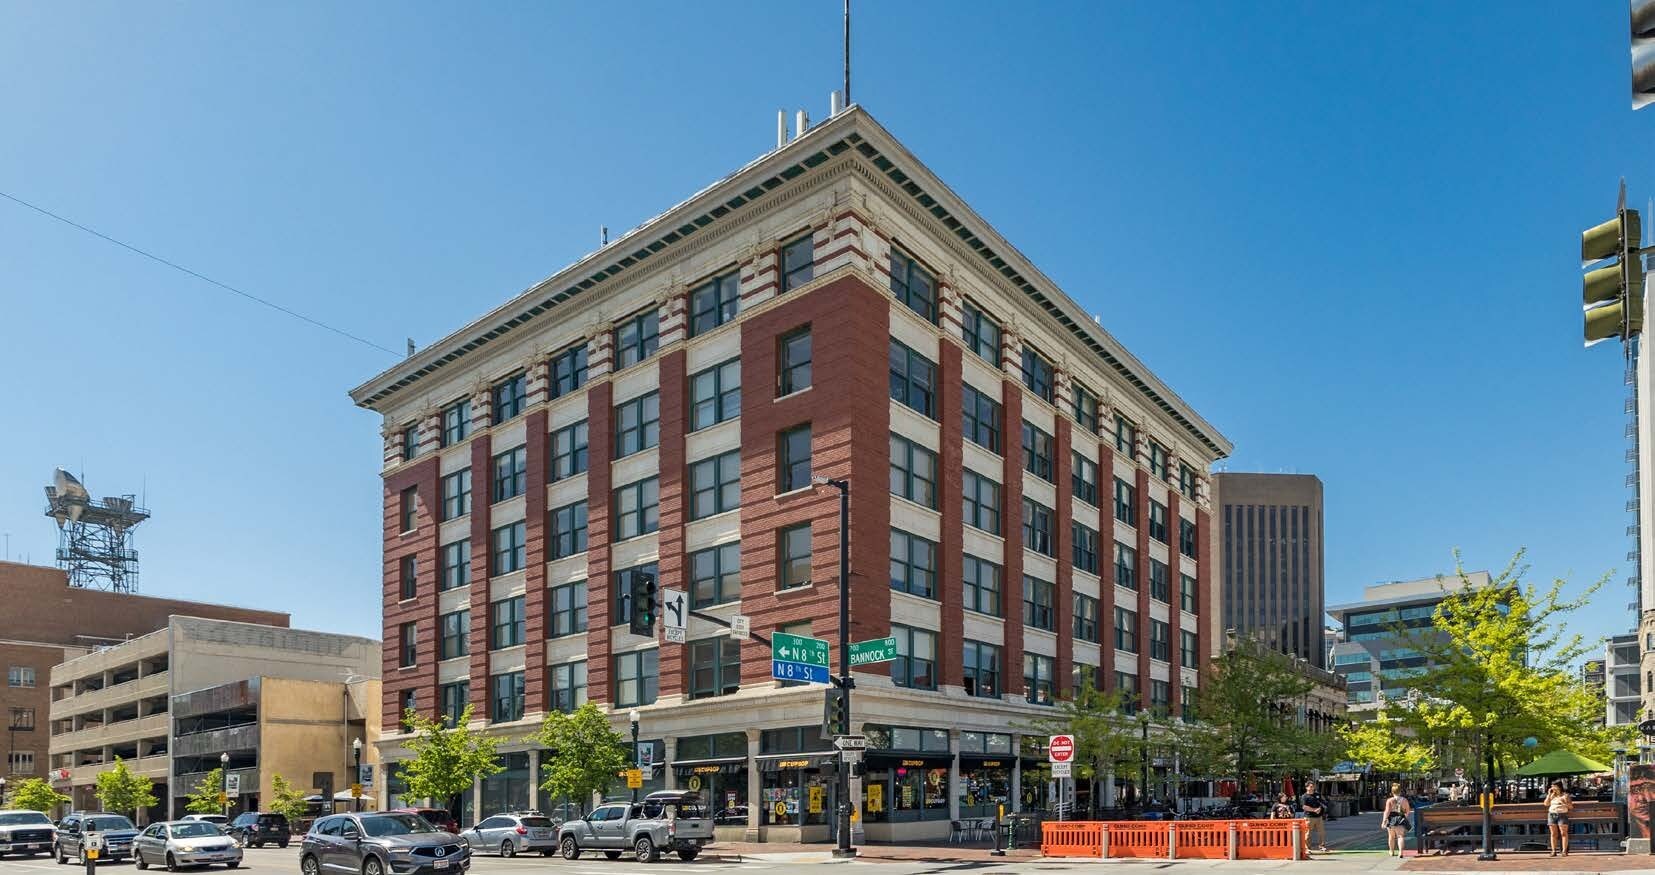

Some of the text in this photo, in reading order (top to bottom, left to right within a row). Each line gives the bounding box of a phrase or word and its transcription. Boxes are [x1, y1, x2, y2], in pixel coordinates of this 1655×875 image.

[792, 638, 826, 650] 300 200
[849, 644, 859, 652] 700
[792, 647, 799, 660] N
[801, 648, 807, 662] 8
[817, 651, 826, 665] St
[850, 649, 885, 664] BANNOCK
[777, 663, 785, 676] N
[787, 664, 794, 677] 8
[804, 666, 813, 680] St
[842, 739, 863, 748] ONE WAY
